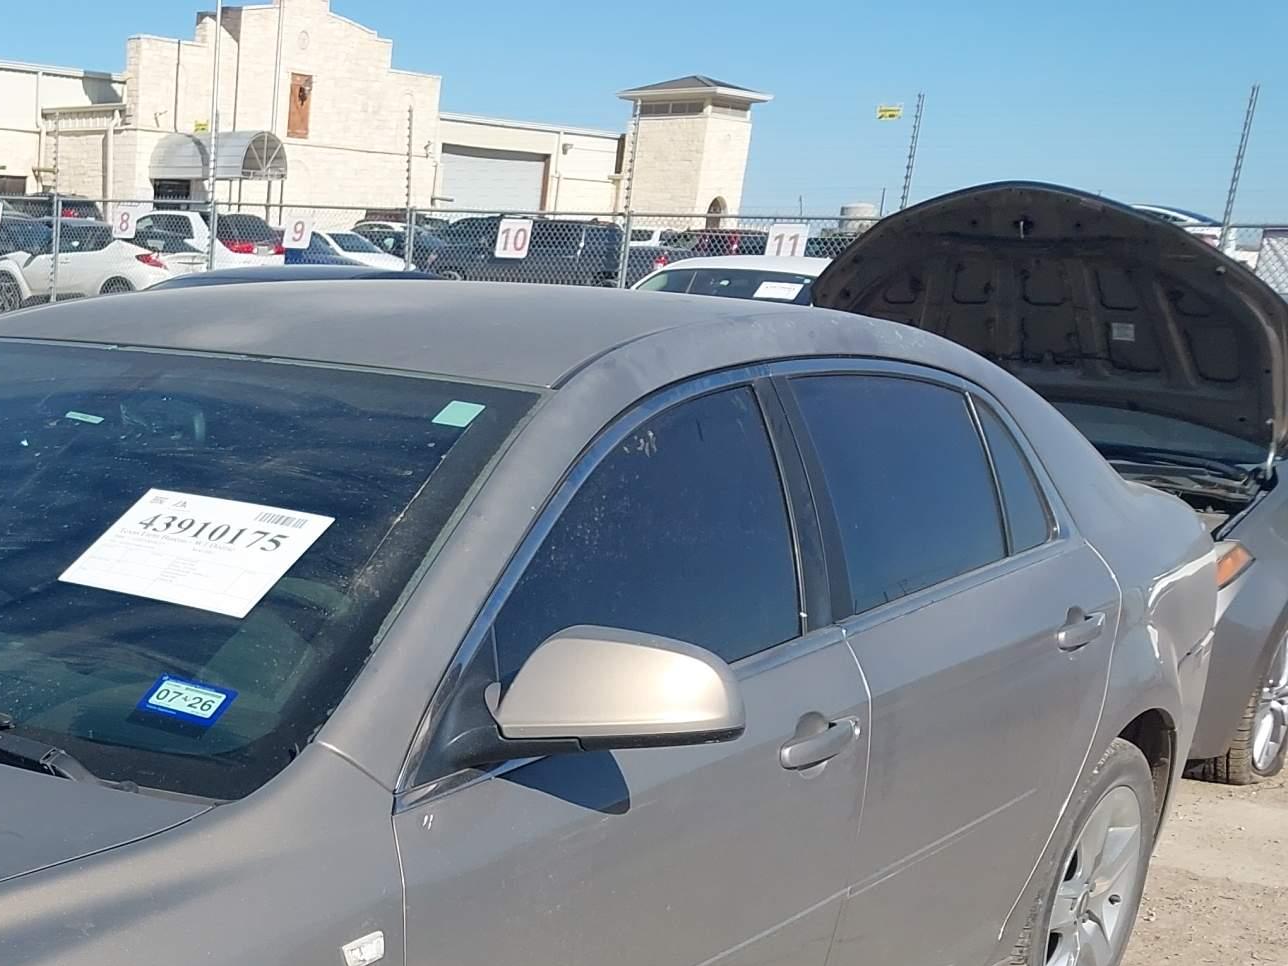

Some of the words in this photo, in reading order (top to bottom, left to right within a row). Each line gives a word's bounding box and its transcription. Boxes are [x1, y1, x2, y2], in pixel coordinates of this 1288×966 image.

[120, 212, 131, 232] 8
[292, 220, 305, 242] 9
[502, 227, 528, 252] 10
[773, 232, 802, 256] 11
[138, 513, 289, 552] 43910175
[156, 688, 184, 703] 07
[187, 696, 215, 712] 26
